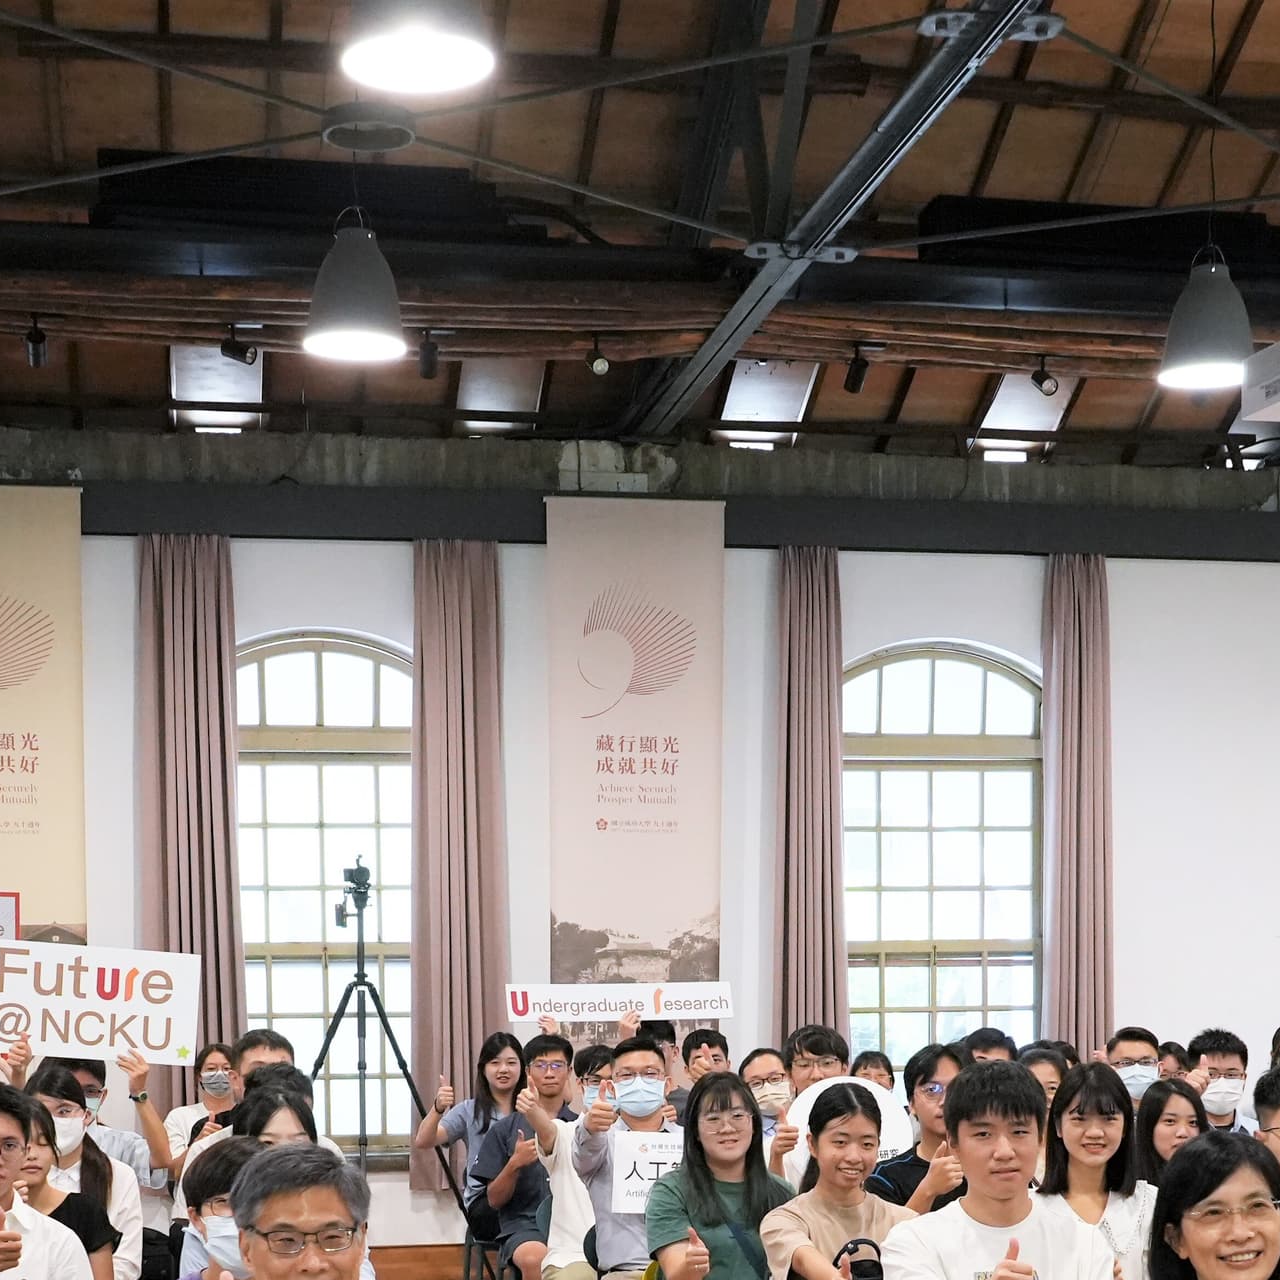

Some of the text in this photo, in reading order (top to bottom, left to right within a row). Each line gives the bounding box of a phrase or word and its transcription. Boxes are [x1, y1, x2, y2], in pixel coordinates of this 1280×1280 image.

[596, 734, 679, 753] 藏行顯光
[596, 756, 679, 776] 成就共好
[510, 991, 645, 1017] Undergraduate
[624, 1160, 682, 1181] 人工
